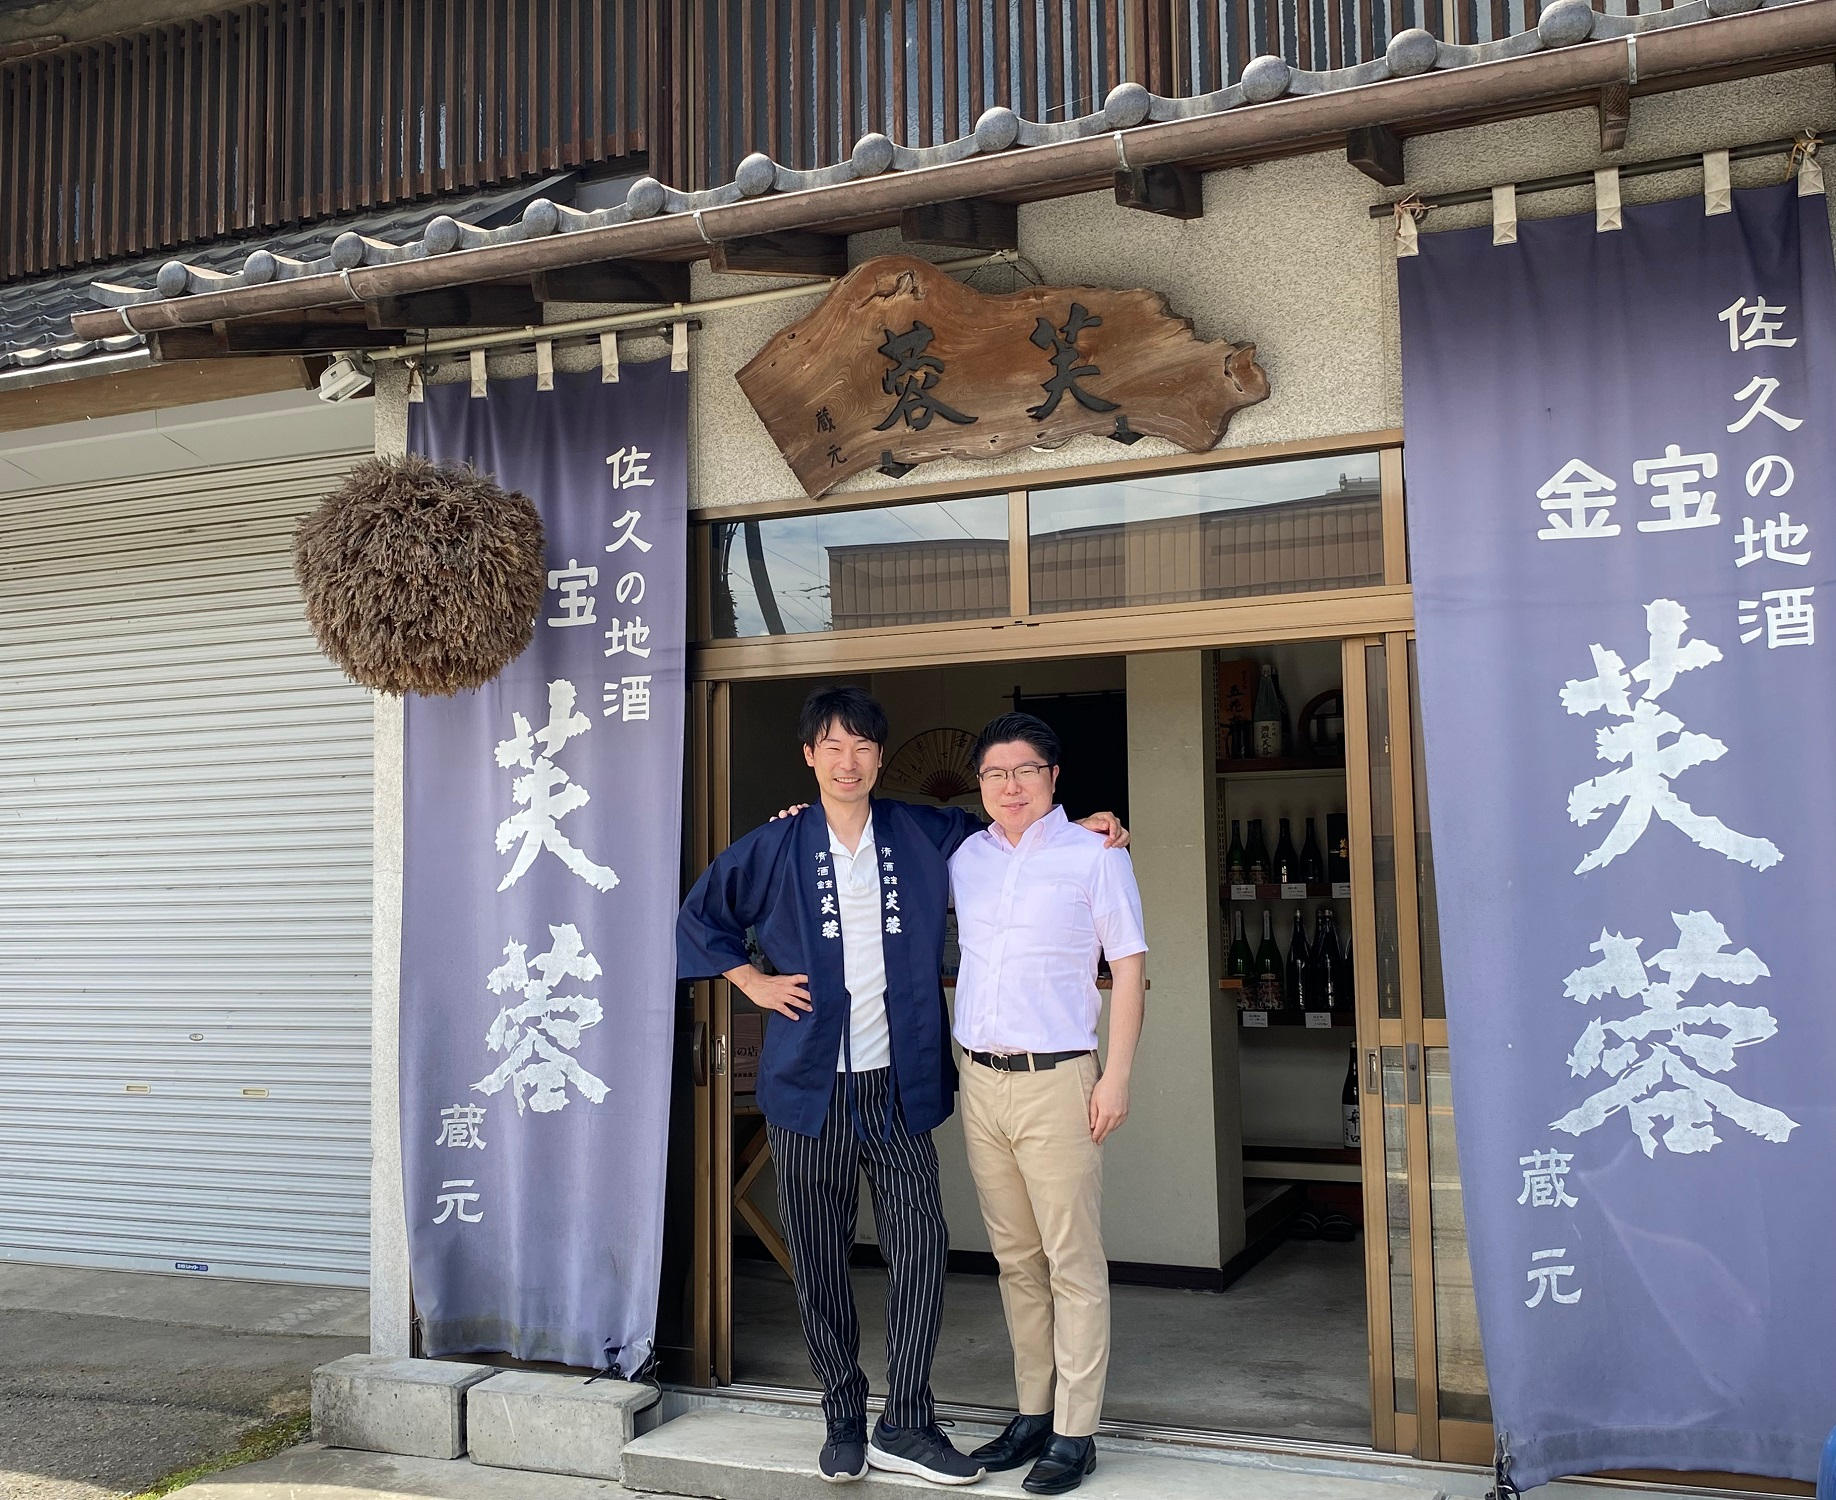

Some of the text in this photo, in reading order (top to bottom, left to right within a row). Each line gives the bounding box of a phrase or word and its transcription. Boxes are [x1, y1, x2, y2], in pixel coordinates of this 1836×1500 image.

[815, 406, 849, 468] 蔵元
[1536, 444, 1721, 541] 金宝
[1718, 295, 1815, 649] 佐久の地酒
[531, 559, 599, 627] 宝
[603, 445, 655, 722] 佐久の地酒
[469, 678, 621, 1116] 芙蓉
[1548, 598, 1801, 1159] 芙蓉
[734, 1045, 758, 1057] の店
[433, 1103, 488, 1225] 蔵元
[1517, 1148, 1583, 1307] 蔵元
